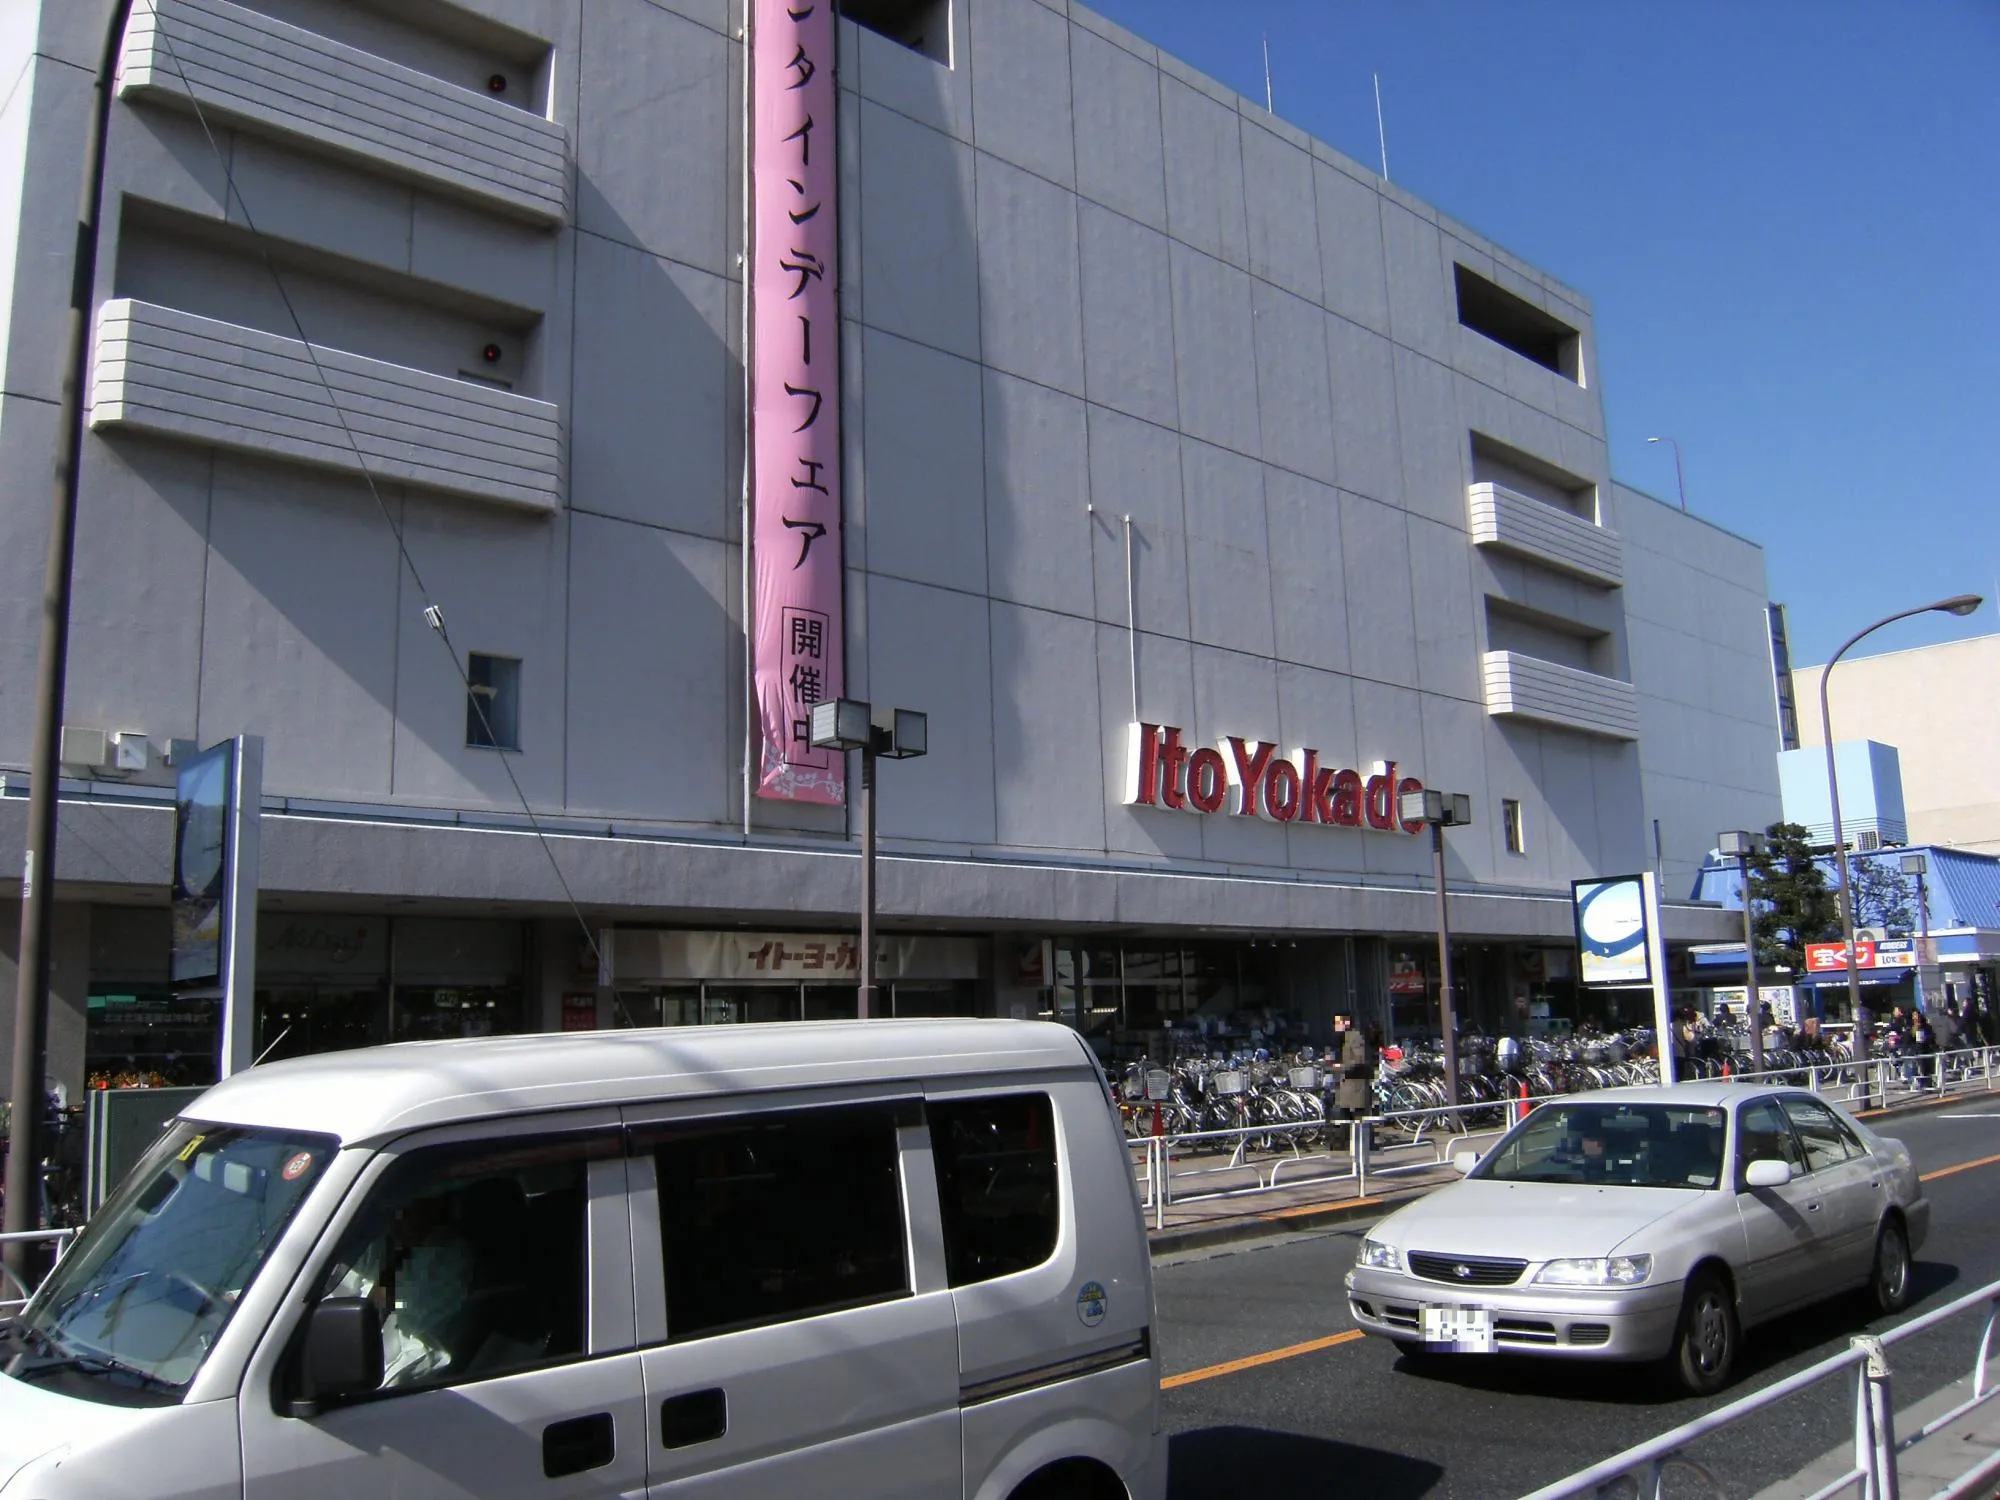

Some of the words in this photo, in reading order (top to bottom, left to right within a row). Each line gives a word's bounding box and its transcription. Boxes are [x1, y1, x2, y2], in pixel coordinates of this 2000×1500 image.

[747, 941, 888, 970] イトーヨーカー
